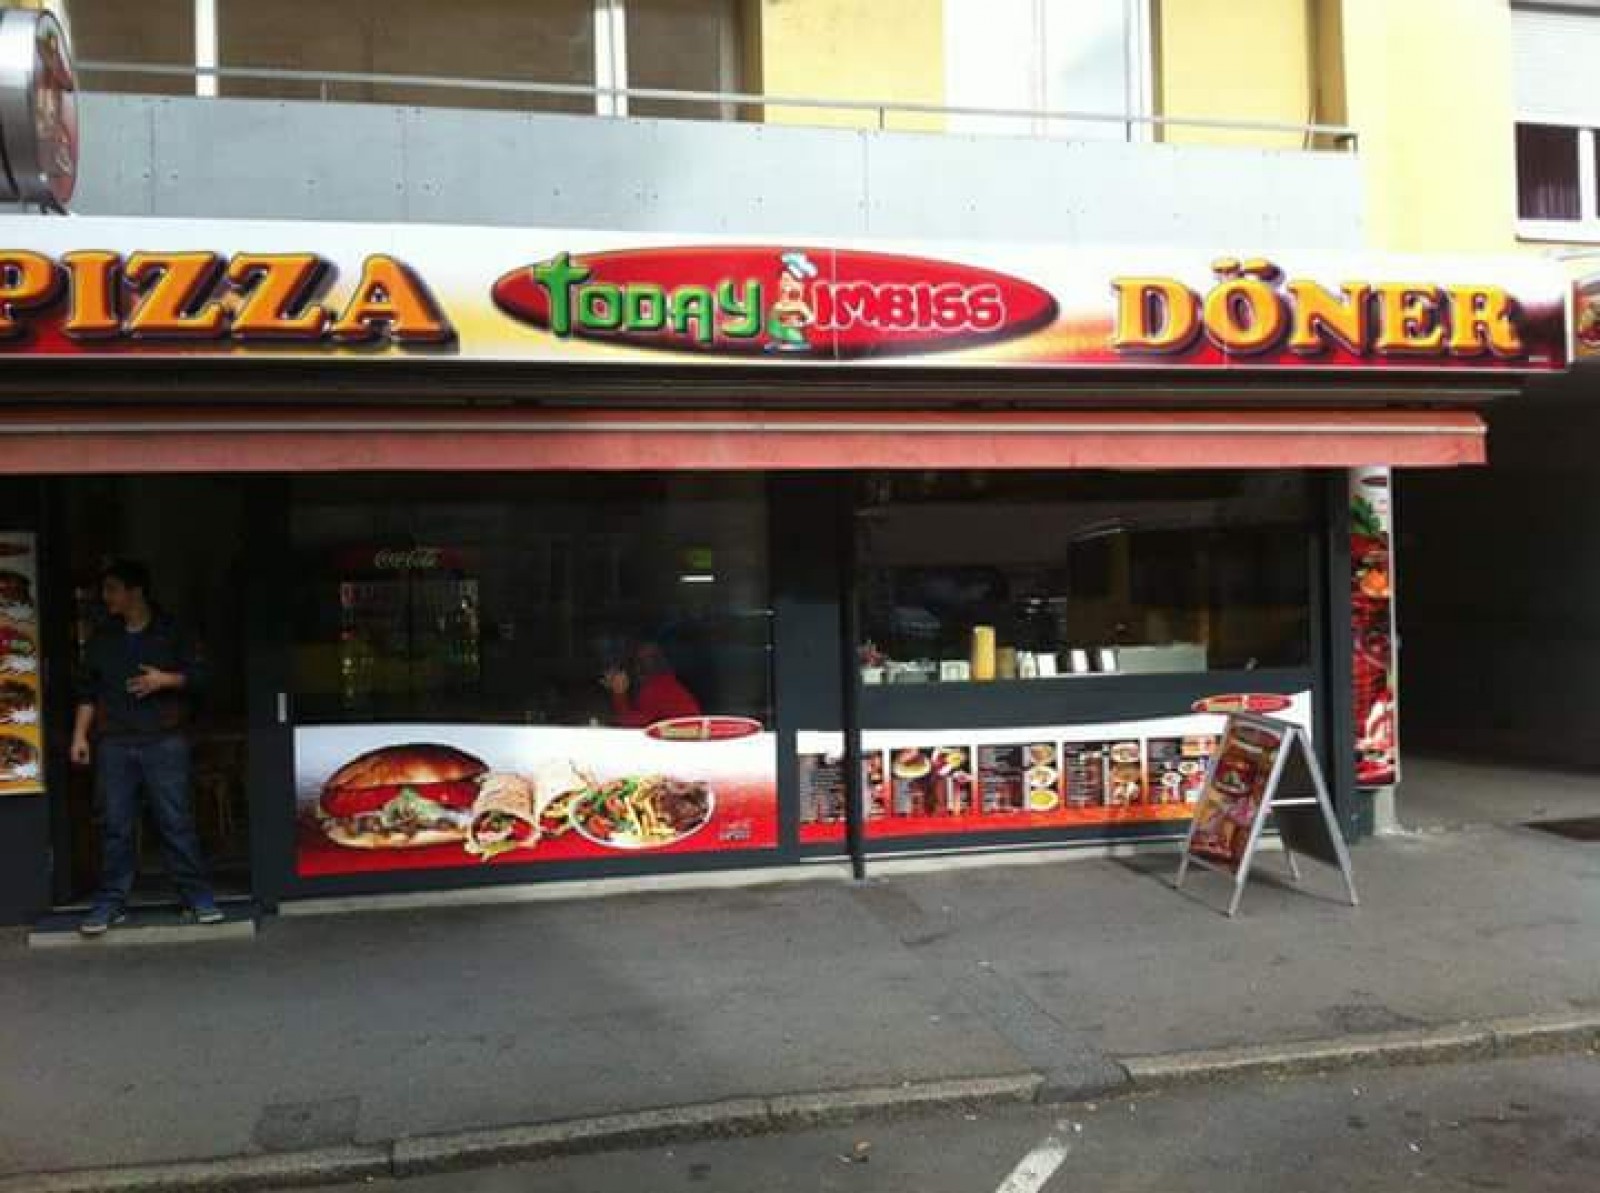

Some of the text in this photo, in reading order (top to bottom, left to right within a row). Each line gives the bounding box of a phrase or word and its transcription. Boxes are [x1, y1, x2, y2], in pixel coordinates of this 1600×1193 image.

[0, 249, 449, 343] PIZZA
[812, 281, 1005, 332] IMBISS
[1112, 258, 1522, 353] DÖNER
